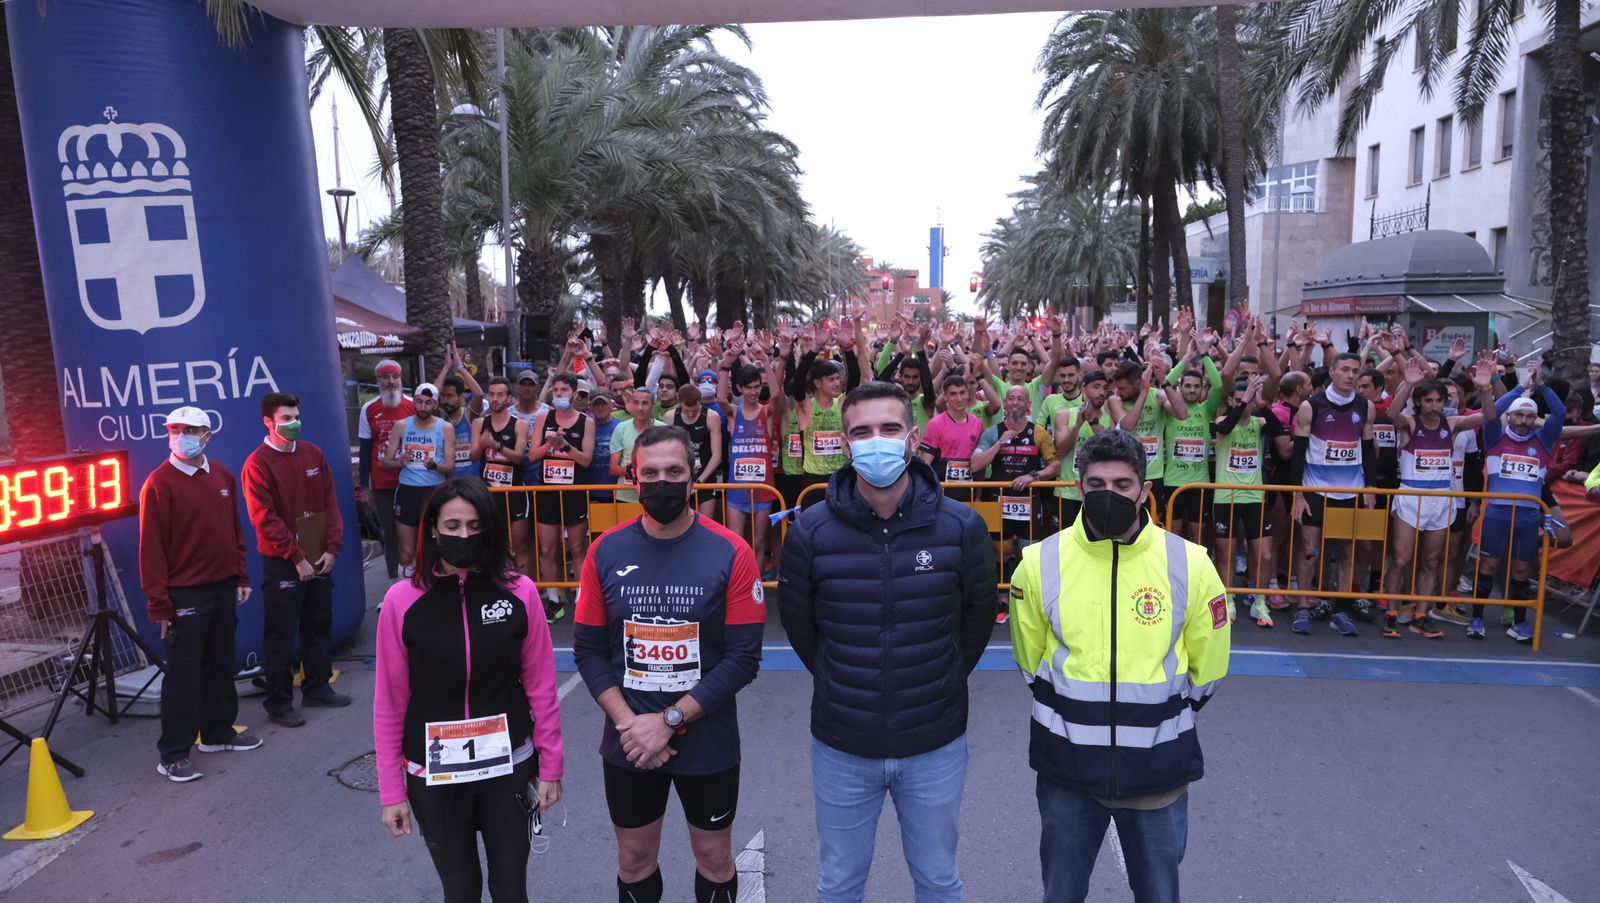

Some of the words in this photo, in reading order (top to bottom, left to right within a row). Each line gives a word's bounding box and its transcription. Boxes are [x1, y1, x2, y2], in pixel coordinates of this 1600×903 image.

[1172, 267, 1209, 278] AERÍA
[64, 347, 280, 408] ALMERÍA
[98, 409, 223, 441] CIUDD
[406, 436, 432, 444] nerja
[732, 444, 768, 453] DELSUR
[1333, 449, 1354, 458] 108
[1236, 456, 1254, 465] 192
[1422, 458, 1446, 466] 3223
[549, 467, 568, 476] 541
[740, 465, 760, 473] 482
[1510, 462, 1534, 473] 187
[489, 470, 508, 481] 463
[953, 468, 971, 477] 314
[1005, 504, 1026, 513] 193
[626, 585, 659, 595] CARRERA
[665, 585, 704, 596] BOMBEROS
[1131, 587, 1166, 600] BOMBEROS
[667, 596, 695, 605] CIUDAD
[481, 604, 506, 620] fap
[660, 605, 669, 613] DEL
[635, 643, 688, 661] 3460
[647, 664, 674, 672] FRANCISCO
[462, 738, 476, 760] 1
